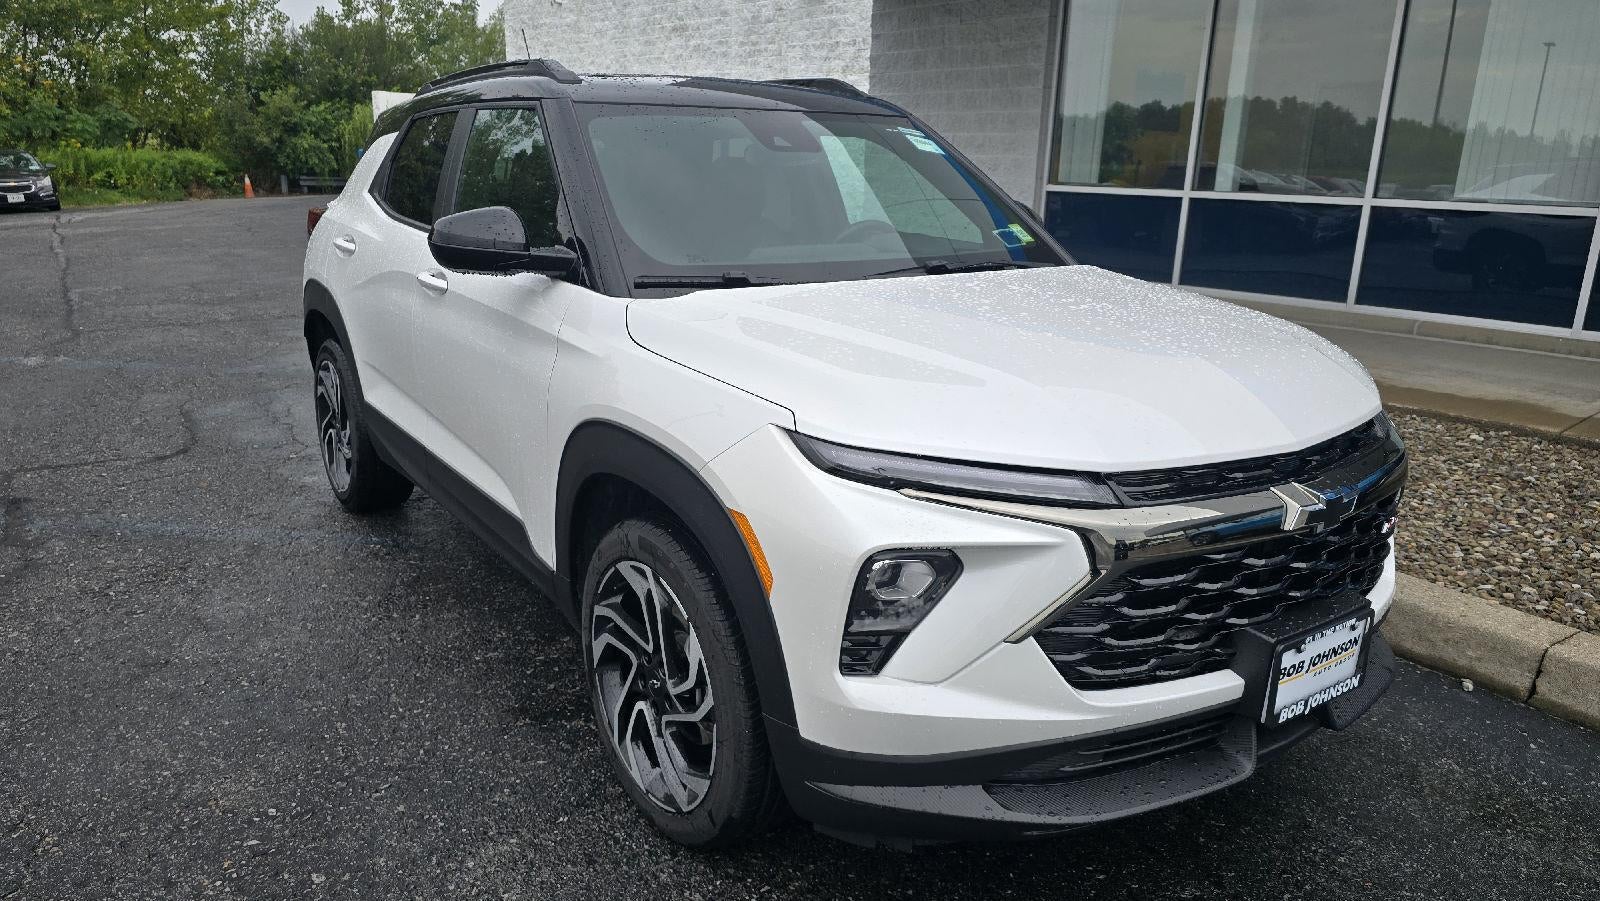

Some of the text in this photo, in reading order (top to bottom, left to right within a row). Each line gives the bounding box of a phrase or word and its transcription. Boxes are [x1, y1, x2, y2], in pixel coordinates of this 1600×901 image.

[1280, 633, 1360, 680] BOB JOHNSON
[1313, 665, 1331, 678] AUTO
[1278, 673, 1360, 723] BOB JOHNSON
